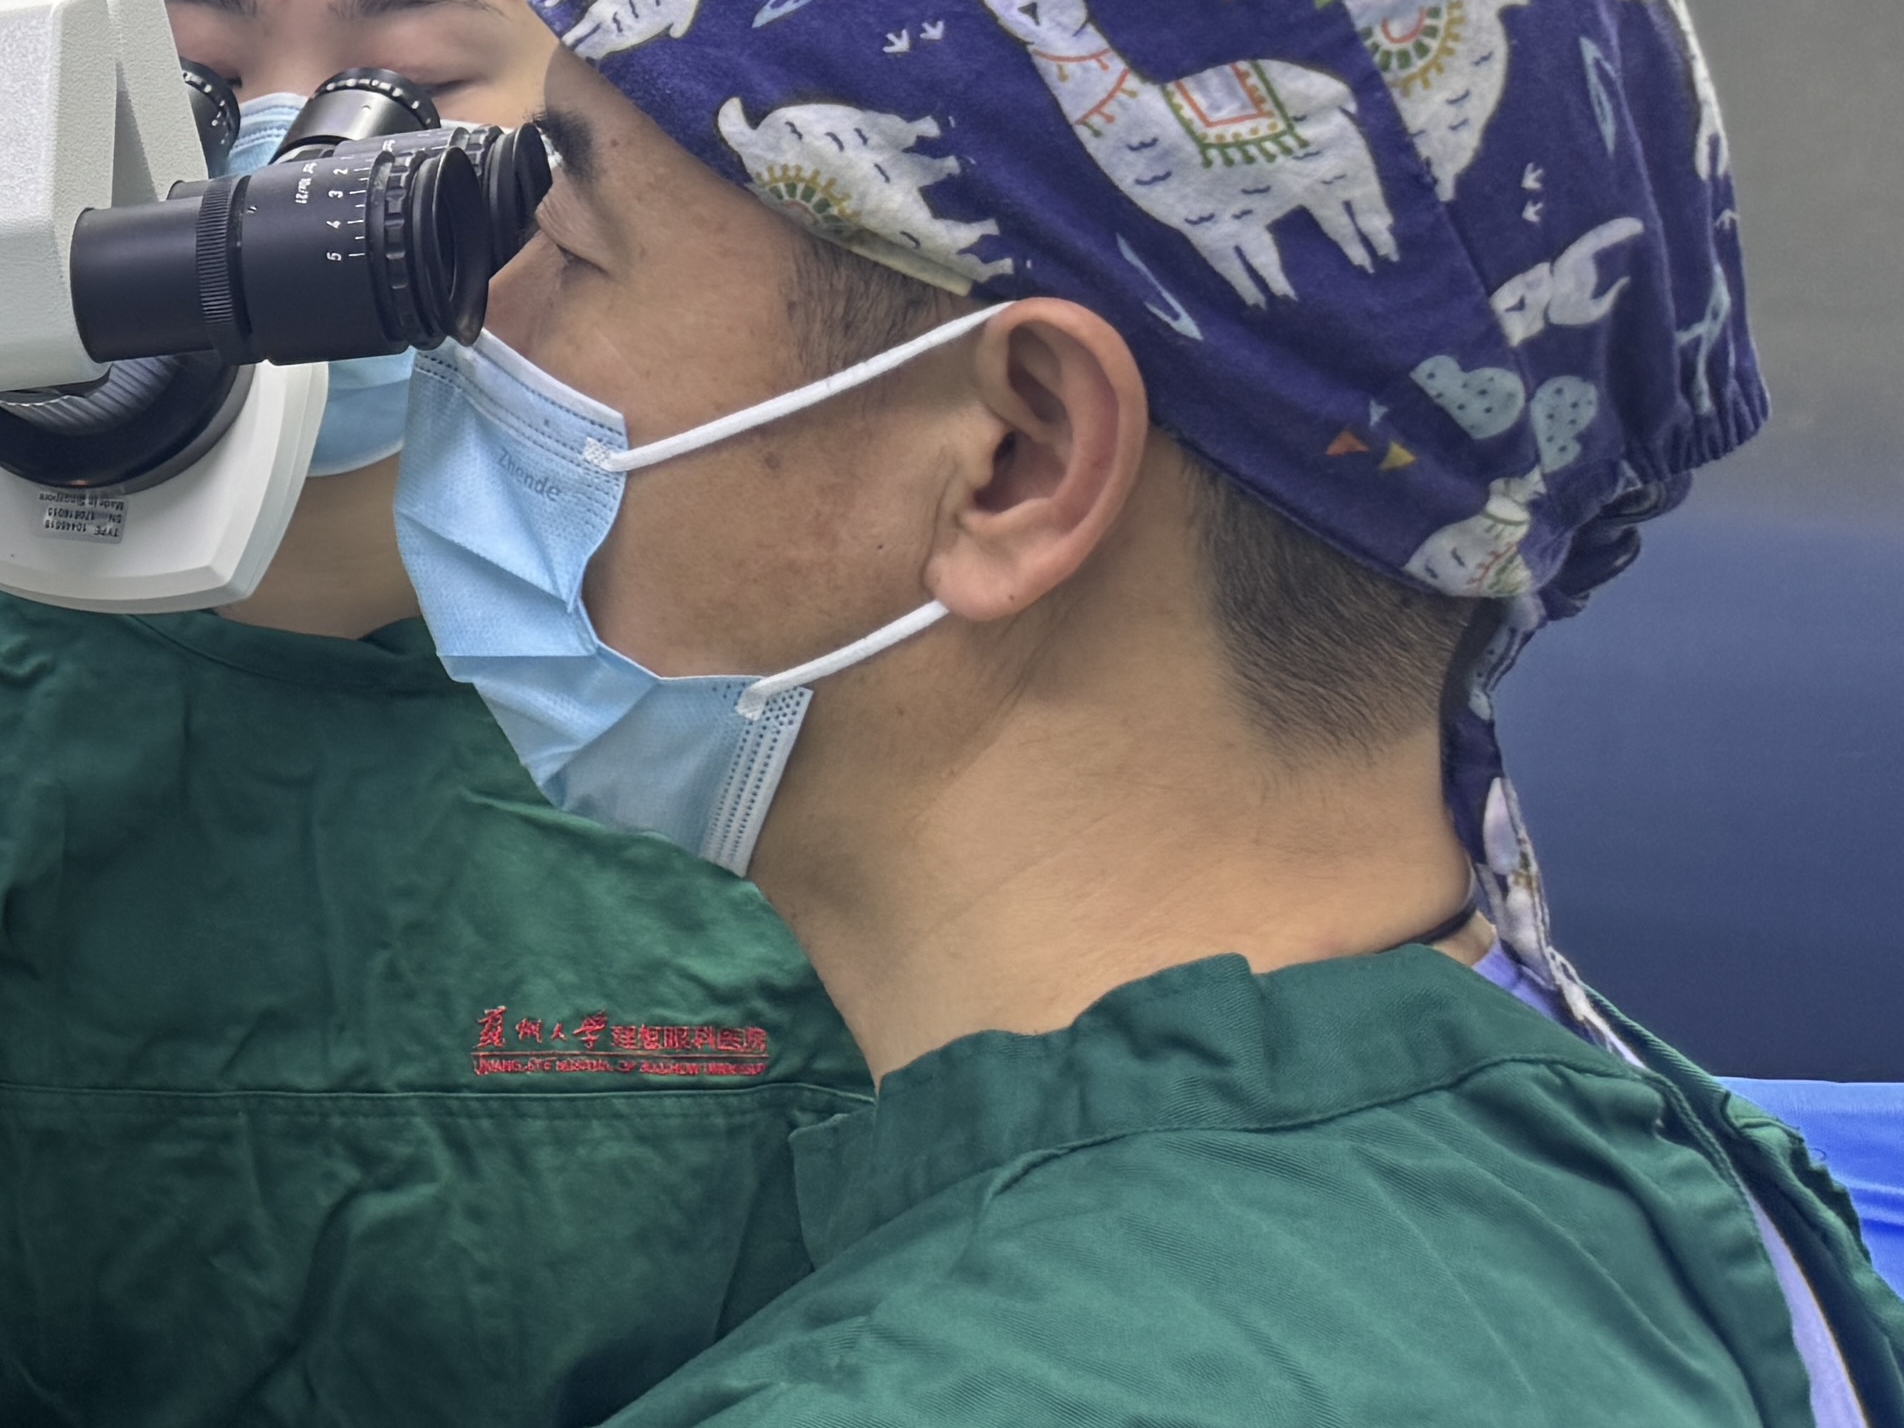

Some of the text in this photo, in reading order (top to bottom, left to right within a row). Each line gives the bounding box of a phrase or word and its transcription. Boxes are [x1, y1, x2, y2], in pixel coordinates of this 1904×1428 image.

[328, 190, 344, 199] 3
[326, 219, 341, 230] 4
[326, 252, 342, 262] 5
[497, 446, 562, 502] Zhende
